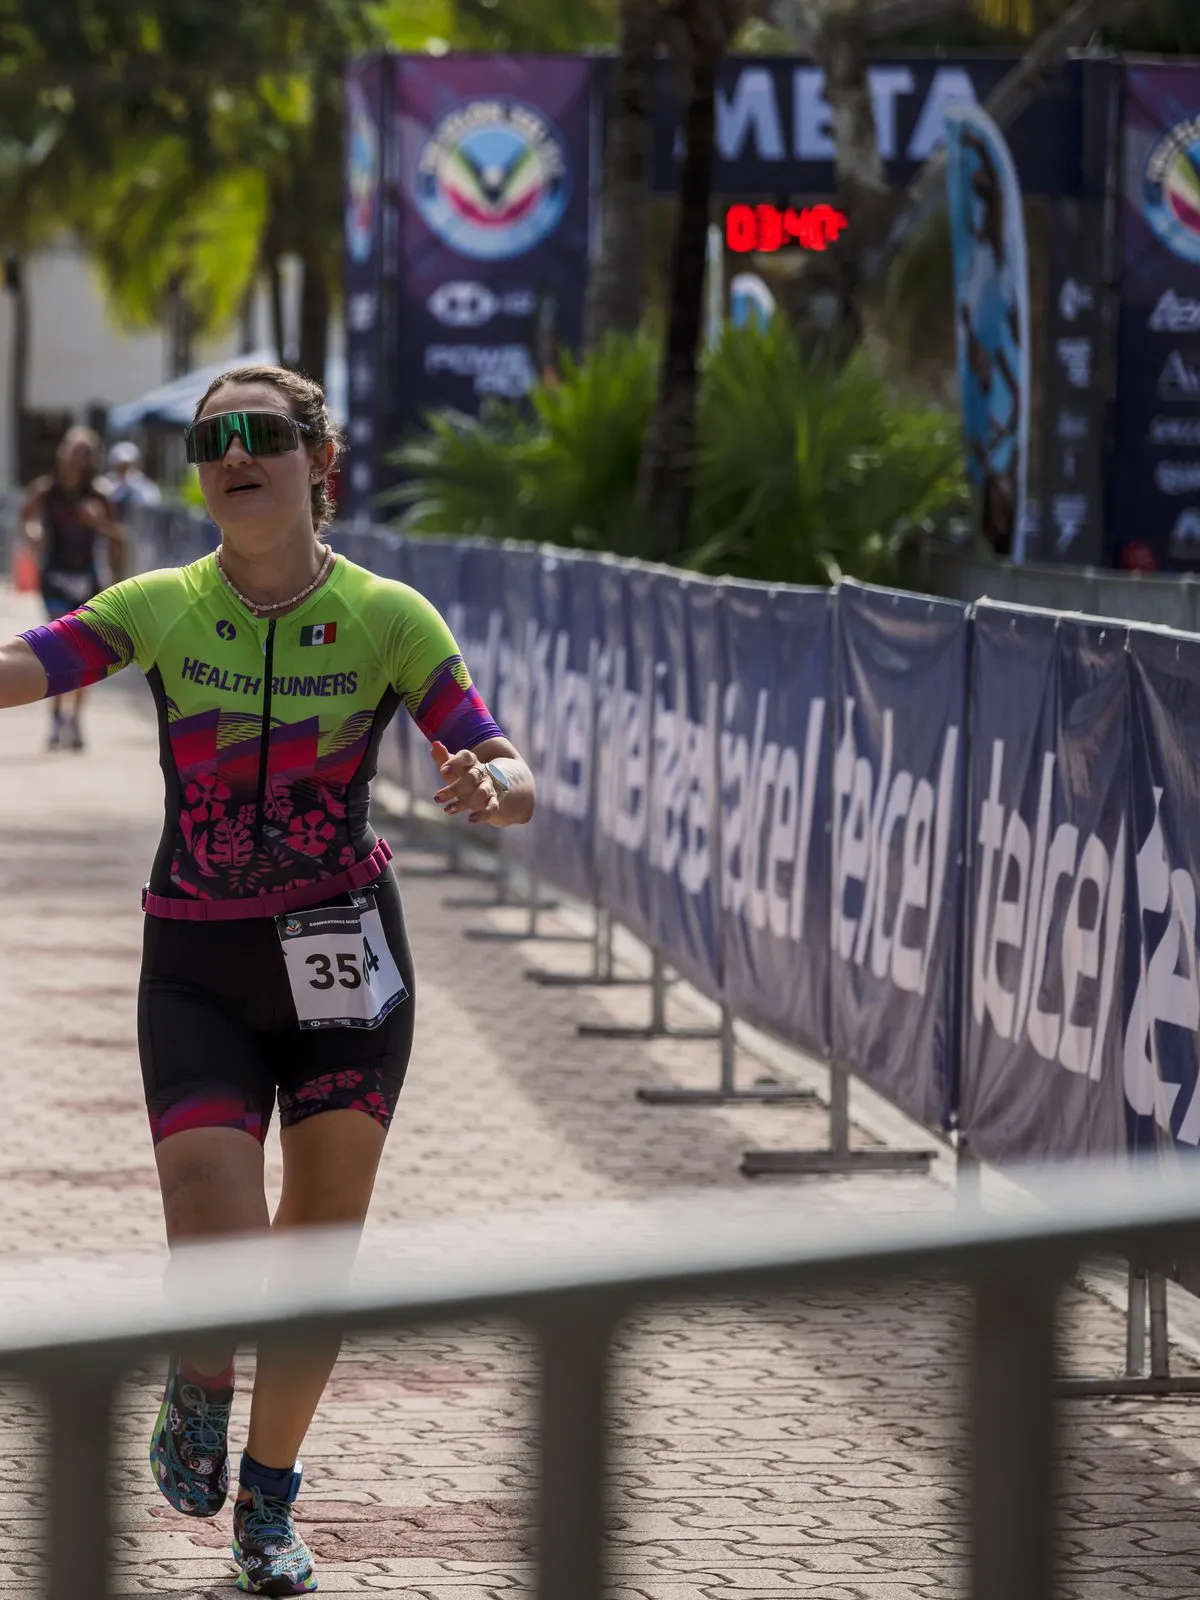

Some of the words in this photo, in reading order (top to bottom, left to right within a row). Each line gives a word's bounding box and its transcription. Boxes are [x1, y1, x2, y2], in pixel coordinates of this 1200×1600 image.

[673, 64, 981, 161] META
[181, 656, 261, 696] HEALTH
[269, 670, 358, 697] RUNNERS
[831, 697, 959, 996] telcel
[973, 738, 1126, 1082] telcel
